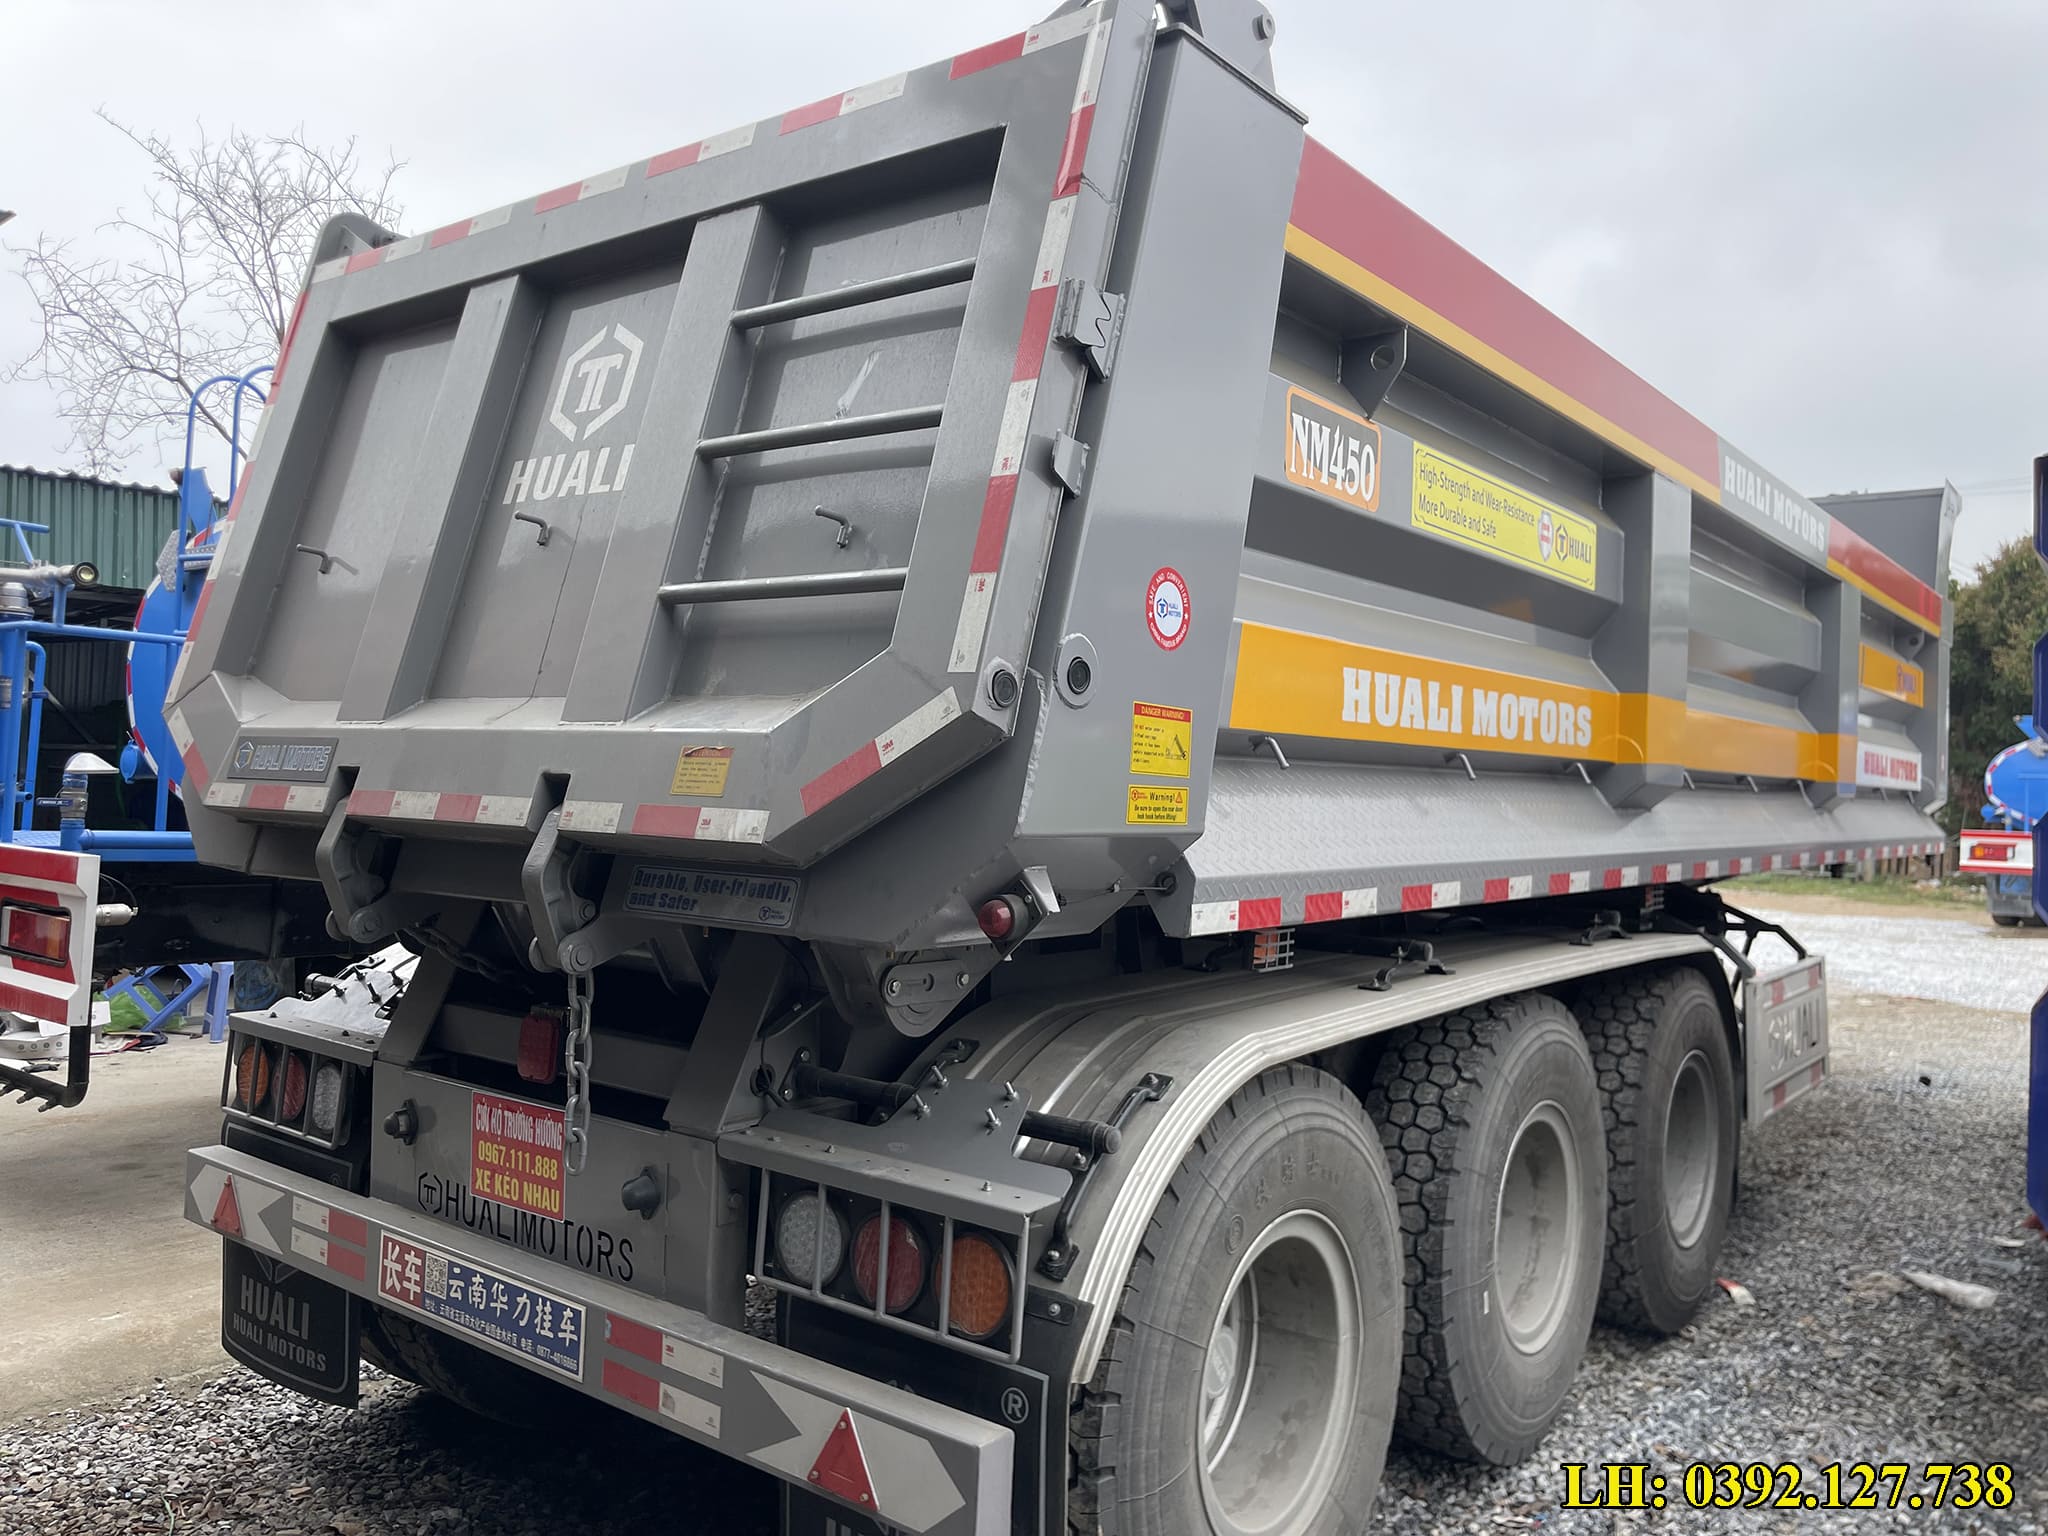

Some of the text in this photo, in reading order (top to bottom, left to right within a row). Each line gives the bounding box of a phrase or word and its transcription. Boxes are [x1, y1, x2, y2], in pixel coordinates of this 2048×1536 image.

[503, 443, 636, 505] HUALI
[1290, 412, 1376, 502] NM450
[1419, 493, 1497, 538] More Durable and Safe
[1420, 462, 1535, 526] High-Strength and Wear-Resistance
[1725, 455, 1825, 552] HUALI MOTORS
[1568, 536, 1592, 564] HUALI
[1342, 667, 1592, 747] HUALI MOTORS
[250, 744, 332, 772] HUALI MOTORS
[1863, 751, 1918, 782] HUALI MOTORS
[628, 892, 698, 912] and Safer
[490, 1103, 502, 1142] HỘ
[478, 1140, 558, 1180] 0967.111.888
[476, 1168, 560, 1213] XE KÉO NHAU
[240, 1274, 310, 1340] HUALI
[384, 1241, 578, 1348] 长车 云南华力挂车
[233, 1312, 326, 1372] HUALI MOTORS
